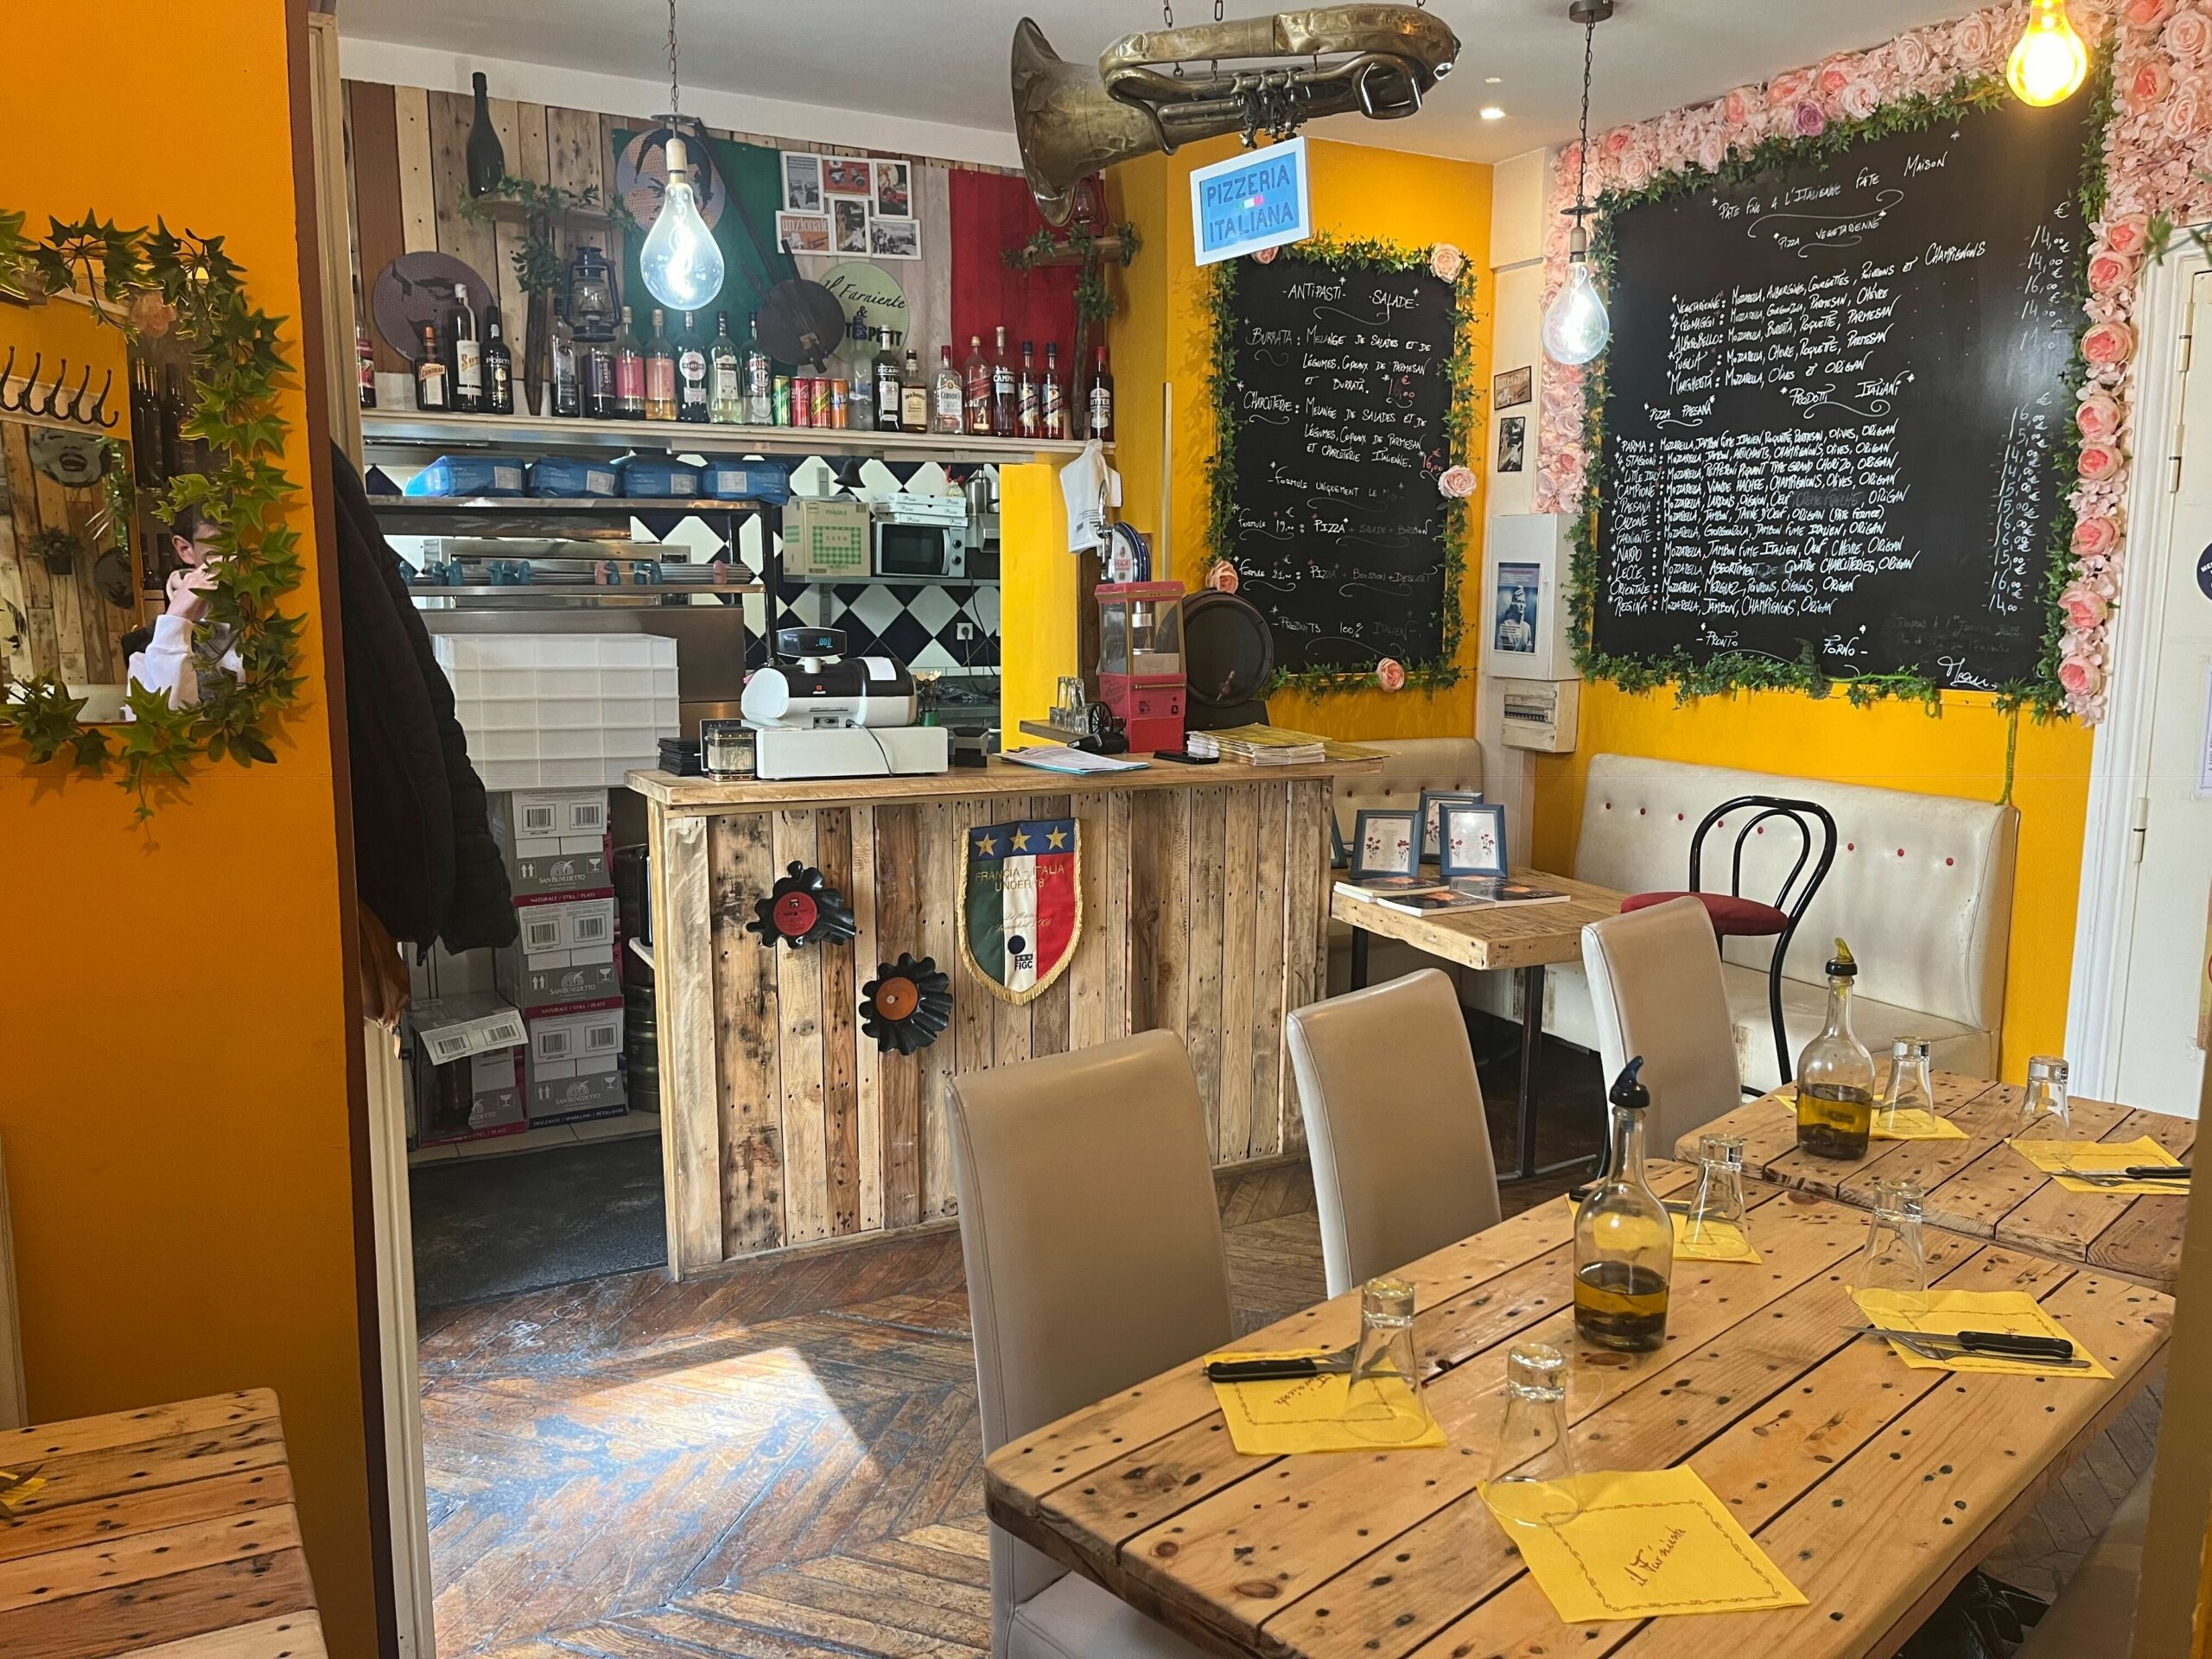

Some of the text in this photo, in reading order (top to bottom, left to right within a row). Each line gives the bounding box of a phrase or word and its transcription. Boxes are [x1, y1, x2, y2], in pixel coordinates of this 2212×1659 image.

[1904, 151, 1948, 177] MAISON
[1207, 165, 1289, 207] PIZZERIA
[1210, 202, 1294, 242] ITALIANA
[1924, 241, 1986, 266] CHAMPIGNONS
[840, 283, 906, 309] Farniente
[856, 306, 867, 318] &
[1306, 325, 1347, 345] MELANGE
[1393, 358, 1431, 375] PARMESAN
[1824, 351, 1873, 374] ORIGAN
[1306, 376, 1319, 385] ET
[1306, 397, 1337, 419] MELANGE
[1362, 410, 1395, 423] SALADES
[1649, 408, 1670, 422] PIZZA
[1861, 417, 1899, 437] ORIGAN
[1307, 442, 1317, 453] ET
[1322, 446, 1361, 461] CHARCUTERIE
[1388, 434, 1426, 450] PARMESAN
[1855, 436, 1896, 454] ORIGAN
[1858, 451, 1899, 470] ORIGAN
[1859, 467, 1901, 486] ORIGAN
[1316, 481, 1359, 499] UNIQUEMENT
[1369, 488, 1377, 497] LE
[1868, 484, 1911, 504] ORIGAN
[1238, 508, 1266, 528] FORMULE
[1314, 519, 1345, 533] PIZZA
[1792, 508, 1825, 521] ORIGAN
[1849, 521, 1886, 534] ORIGAN
[1868, 536, 1904, 553] ORIGAN
[1878, 550, 1921, 569] ORIGAN
[1310, 566, 1336, 580] PIZZA
[1353, 569, 1385, 581] BOISSON
[1823, 575, 1860, 593] ORIGAN
[1801, 596, 1838, 616] ORIGAN
[1279, 616, 1363, 638] PRODUITS 100%
[1706, 631, 1858, 657] PRONTO FORNO
[551, 873, 586, 883] BENEDETTO
[975, 865, 1065, 882] FRANCIA ITALIA
[995, 880, 1031, 892] UNDER
[1014, 961, 1033, 970] FIGC
[562, 984, 595, 994] BENEDETTO
[568, 1093, 601, 1103] BENEDETTO
[1630, 1524, 1687, 1573] Farniente
